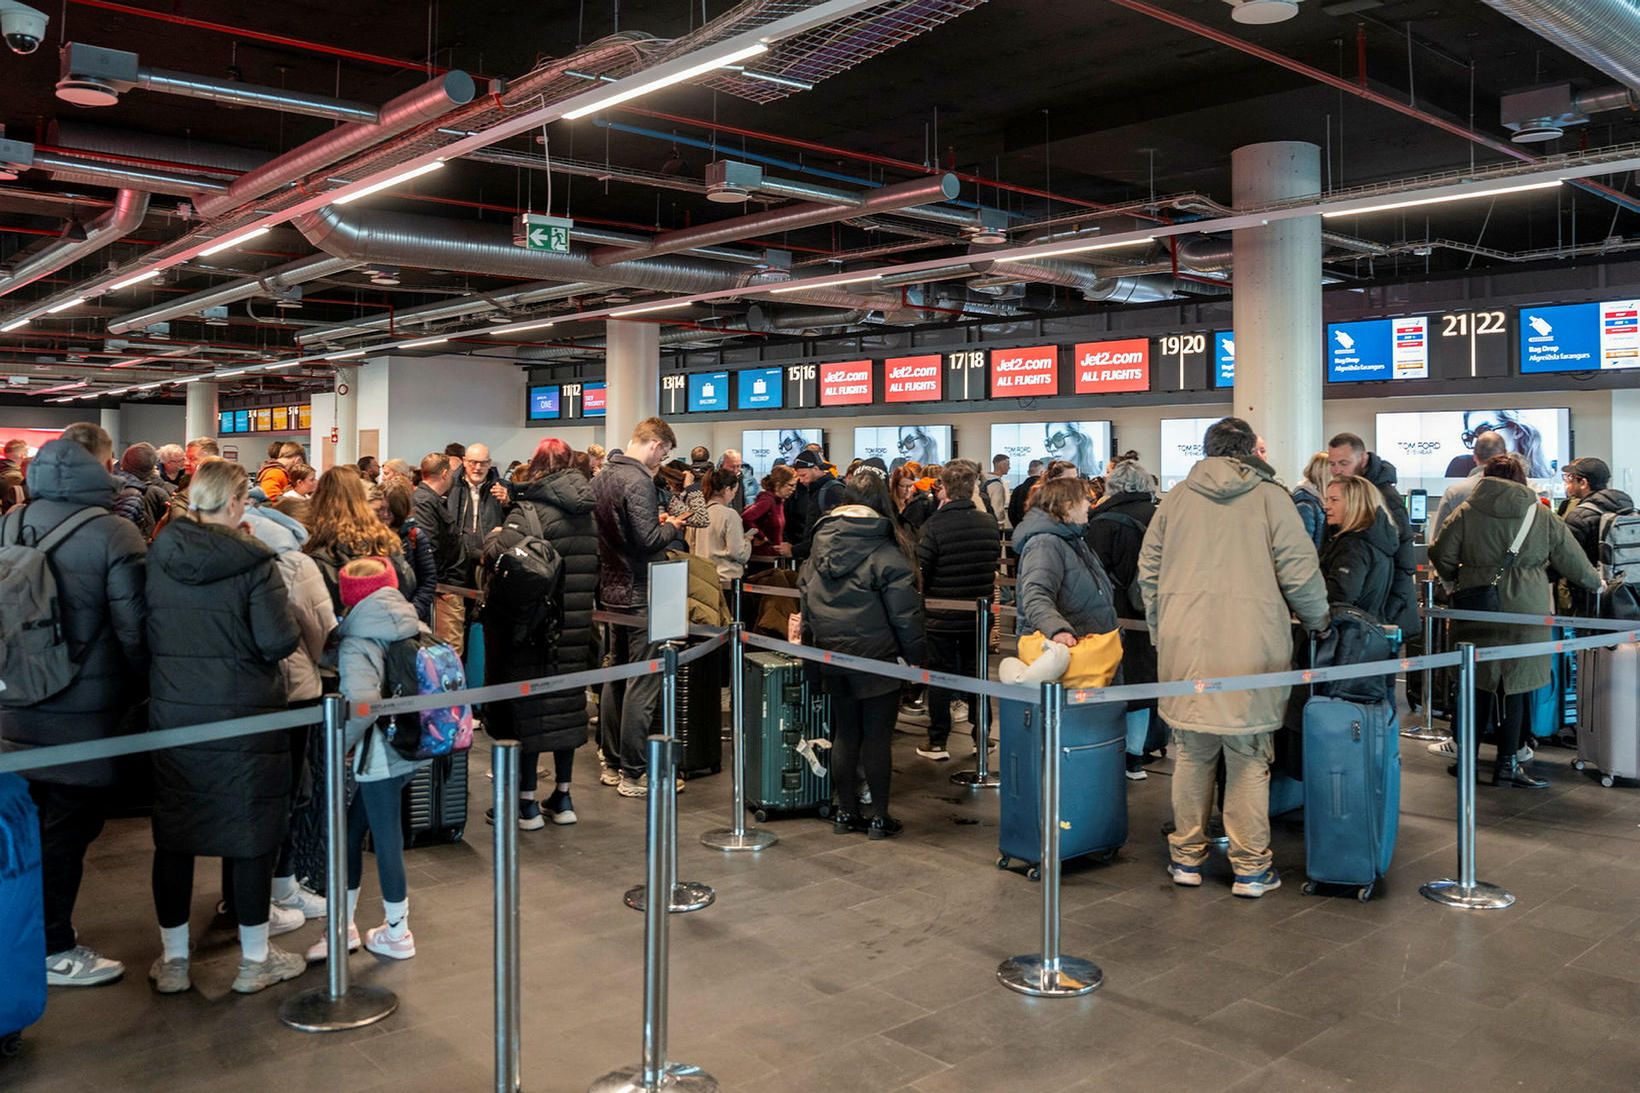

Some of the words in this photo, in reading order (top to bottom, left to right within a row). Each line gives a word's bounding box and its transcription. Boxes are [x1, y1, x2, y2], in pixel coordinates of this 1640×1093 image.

[1442, 314, 1467, 337] 21
[1476, 311, 1506, 335] 22
[1159, 337, 1180, 355] 19
[1183, 335, 1205, 354] 20
[949, 353, 965, 369] 17
[968, 352, 984, 368] 18
[996, 358, 1052, 372] Jet2.com
[1080, 352, 1143, 367] Jet2.com
[788, 367, 800, 381] 15
[803, 365, 816, 380] 16
[824, 371, 868, 383] Jet2.com
[889, 366, 937, 379] Jet2.com
[1081, 371, 1099, 382] ALL
[1101, 369, 1142, 381] FLIGHTS
[662, 376, 672, 389] 13
[674, 375, 685, 388] 14
[890, 383, 904, 392] ALL
[904, 381, 936, 391] FLIGHTS
[997, 376, 1013, 386] ALL
[1014, 374, 1051, 385] FLIGHTS
[562, 384, 570, 396] 11
[573, 384, 581, 396] 12
[825, 387, 838, 396] ALL
[838, 385, 868, 395] FLIGHTS
[288, 407, 292, 415] 5
[294, 406, 299, 415] 6
[1397, 441, 1415, 450] TOM
[1417, 441, 1441, 450] FORD
